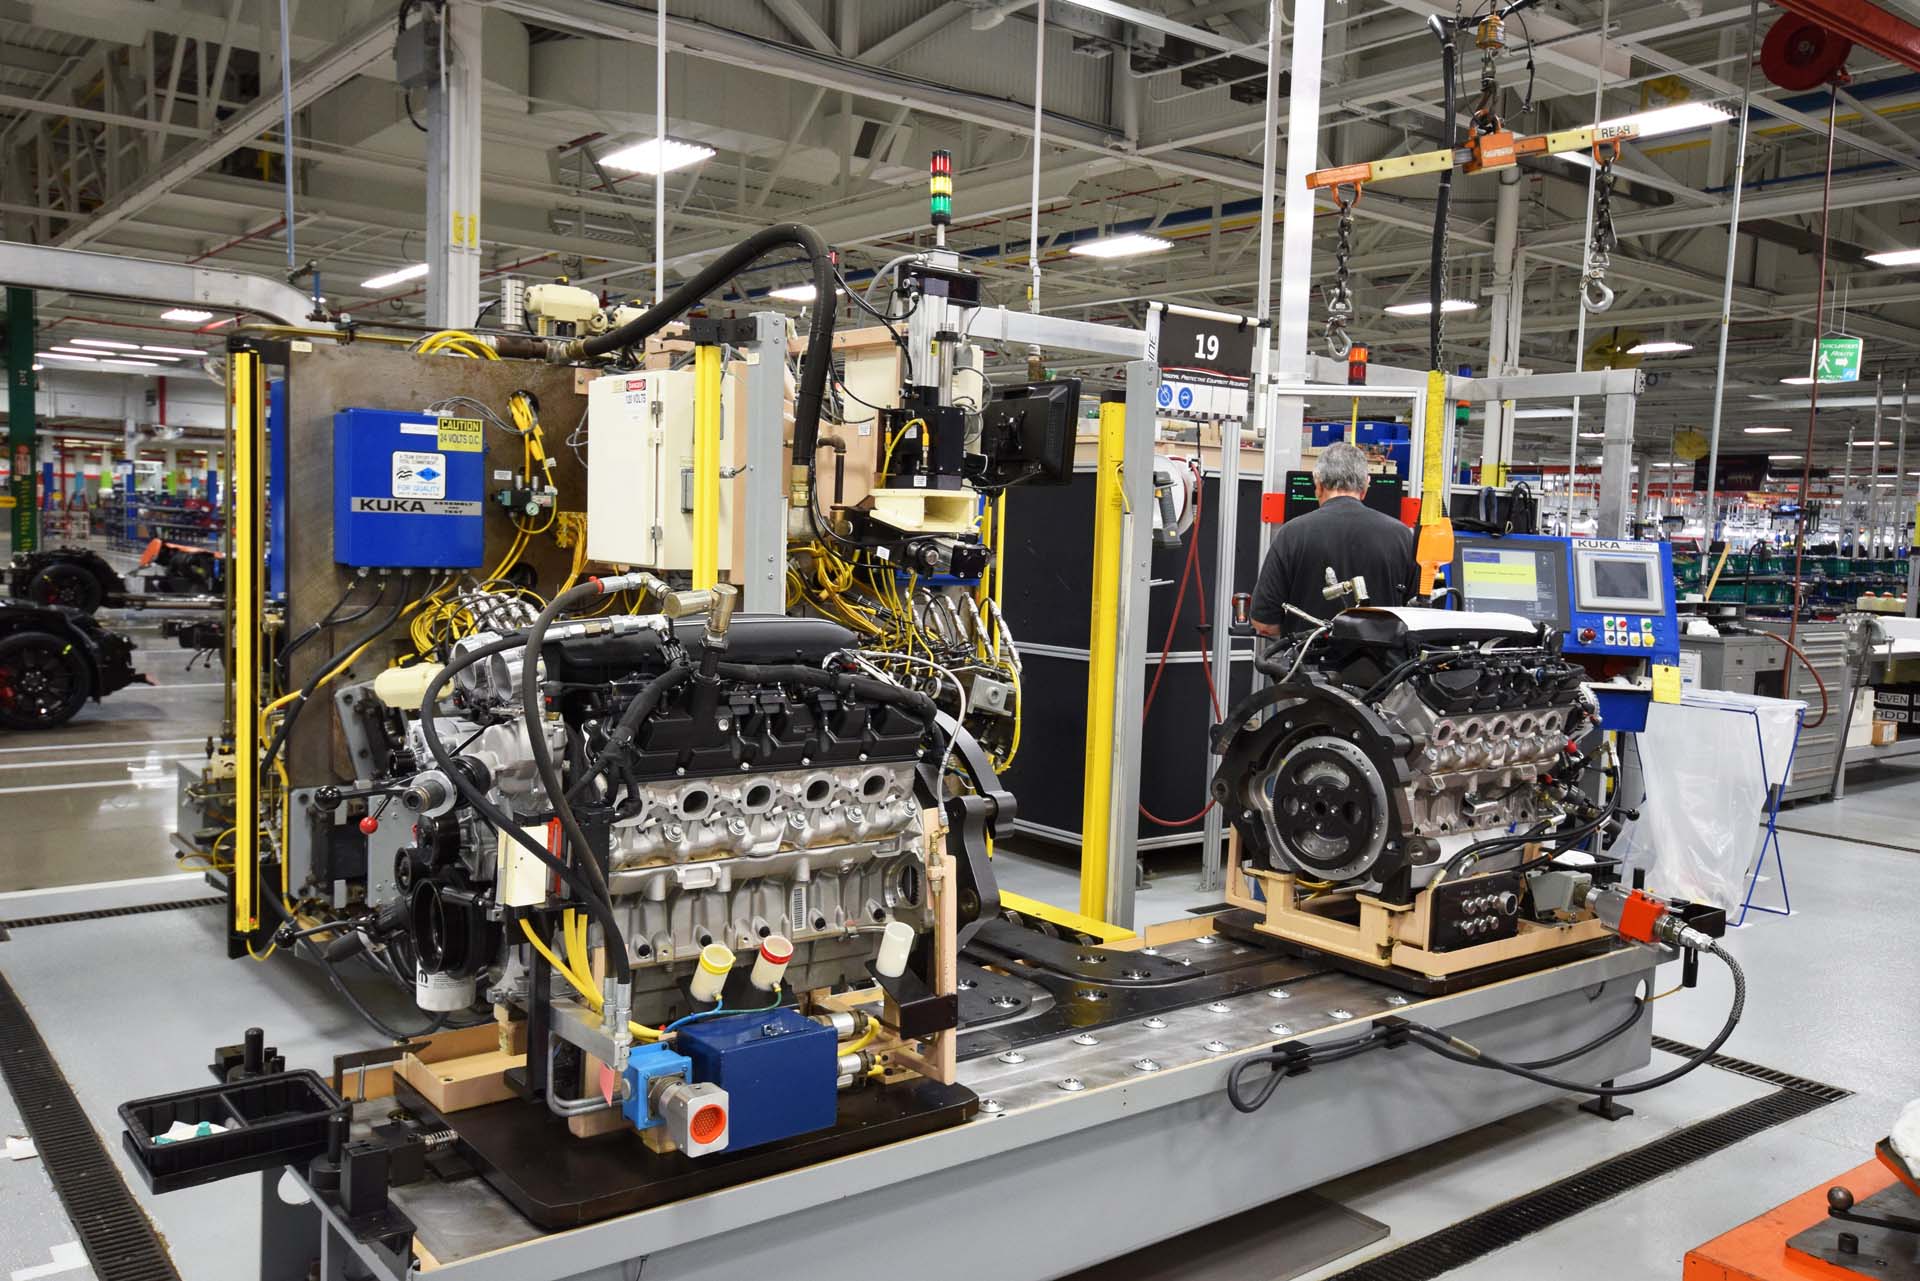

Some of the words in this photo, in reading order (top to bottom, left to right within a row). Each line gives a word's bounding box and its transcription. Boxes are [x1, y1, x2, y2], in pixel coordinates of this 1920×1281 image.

[1601, 125, 1631, 138] REAR
[1194, 333, 1219, 360] 19
[441, 420, 480, 432] CAUTION
[440, 433, 447, 443] 24
[448, 433, 467, 445] VOLTS
[360, 499, 426, 512] KUKA
[1578, 540, 1620, 549] KUKA
[1879, 694, 1908, 704] EVEN
